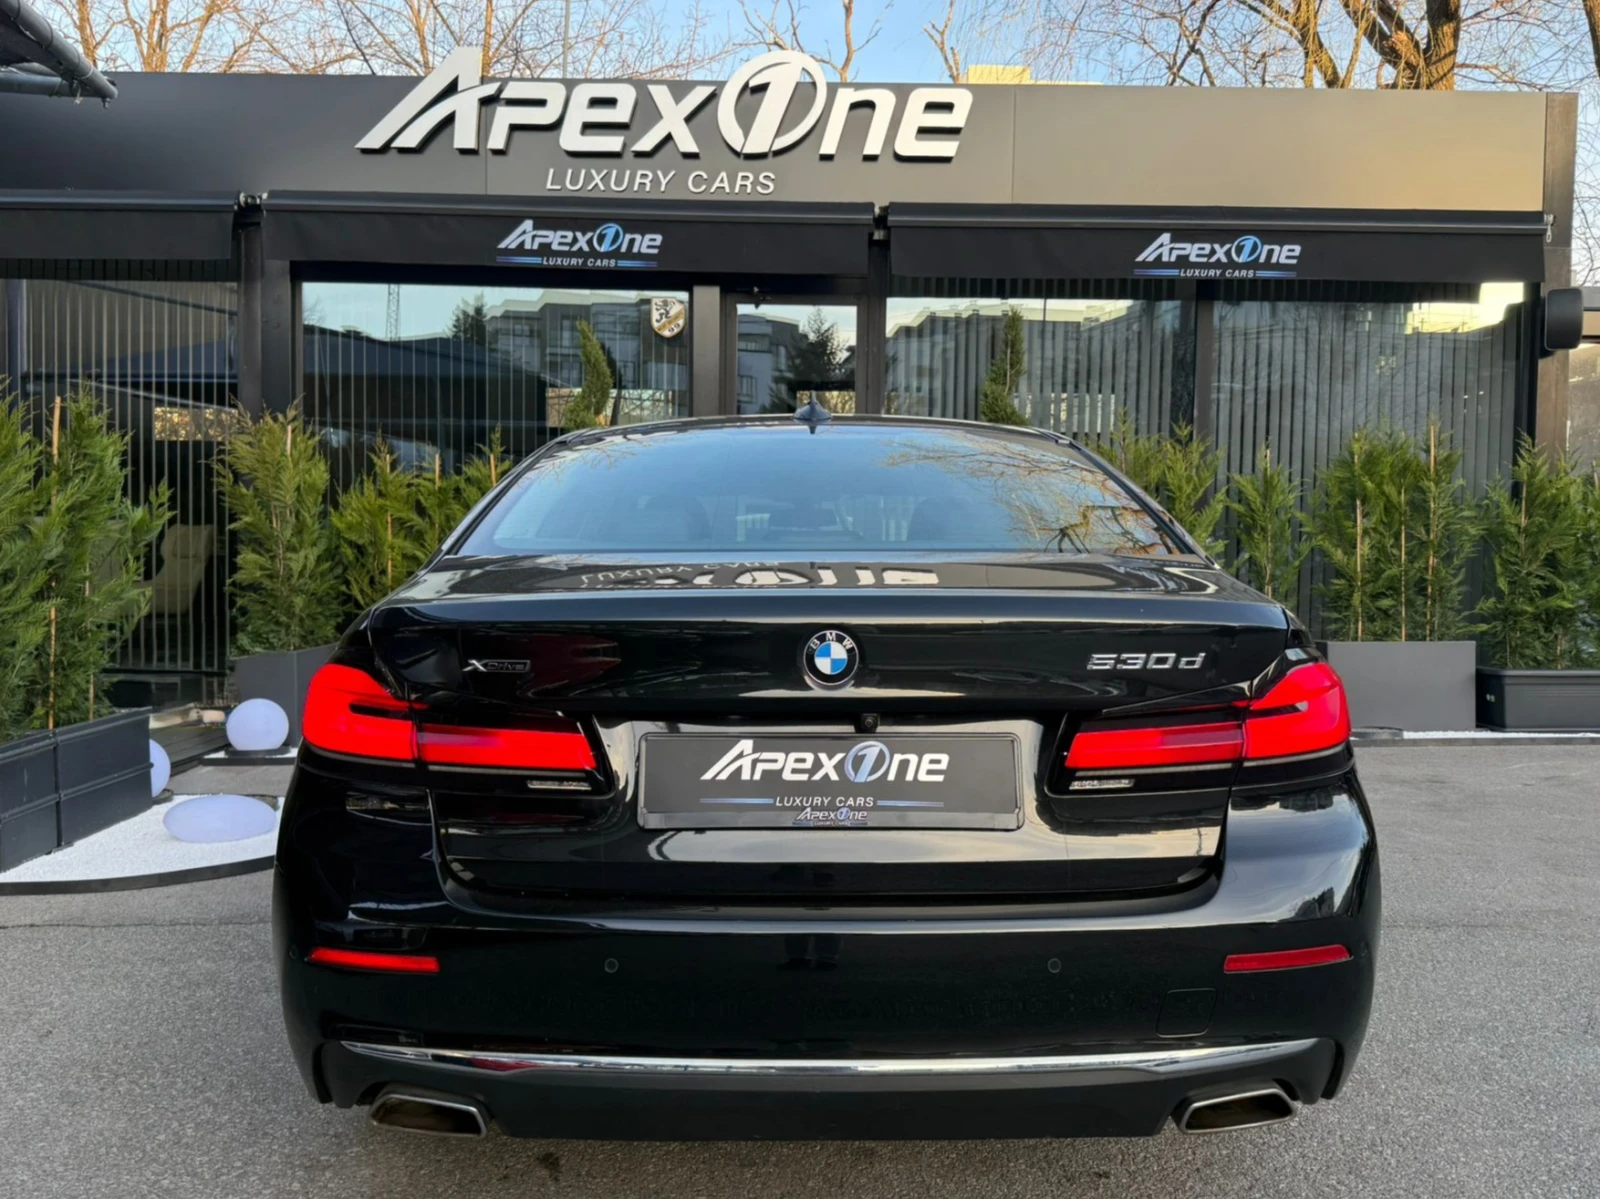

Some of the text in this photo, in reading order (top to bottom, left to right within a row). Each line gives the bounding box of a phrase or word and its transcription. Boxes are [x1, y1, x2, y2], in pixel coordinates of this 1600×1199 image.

[546, 168, 776, 195] LUXURY CARS
[543, 256, 616, 268] LUXURY CARS
[1180, 269, 1254, 279] LUXURY CARS
[810, 631, 853, 650] BMW
[1087, 652, 1206, 670] 530d
[775, 796, 874, 807] LUXURY CARS
